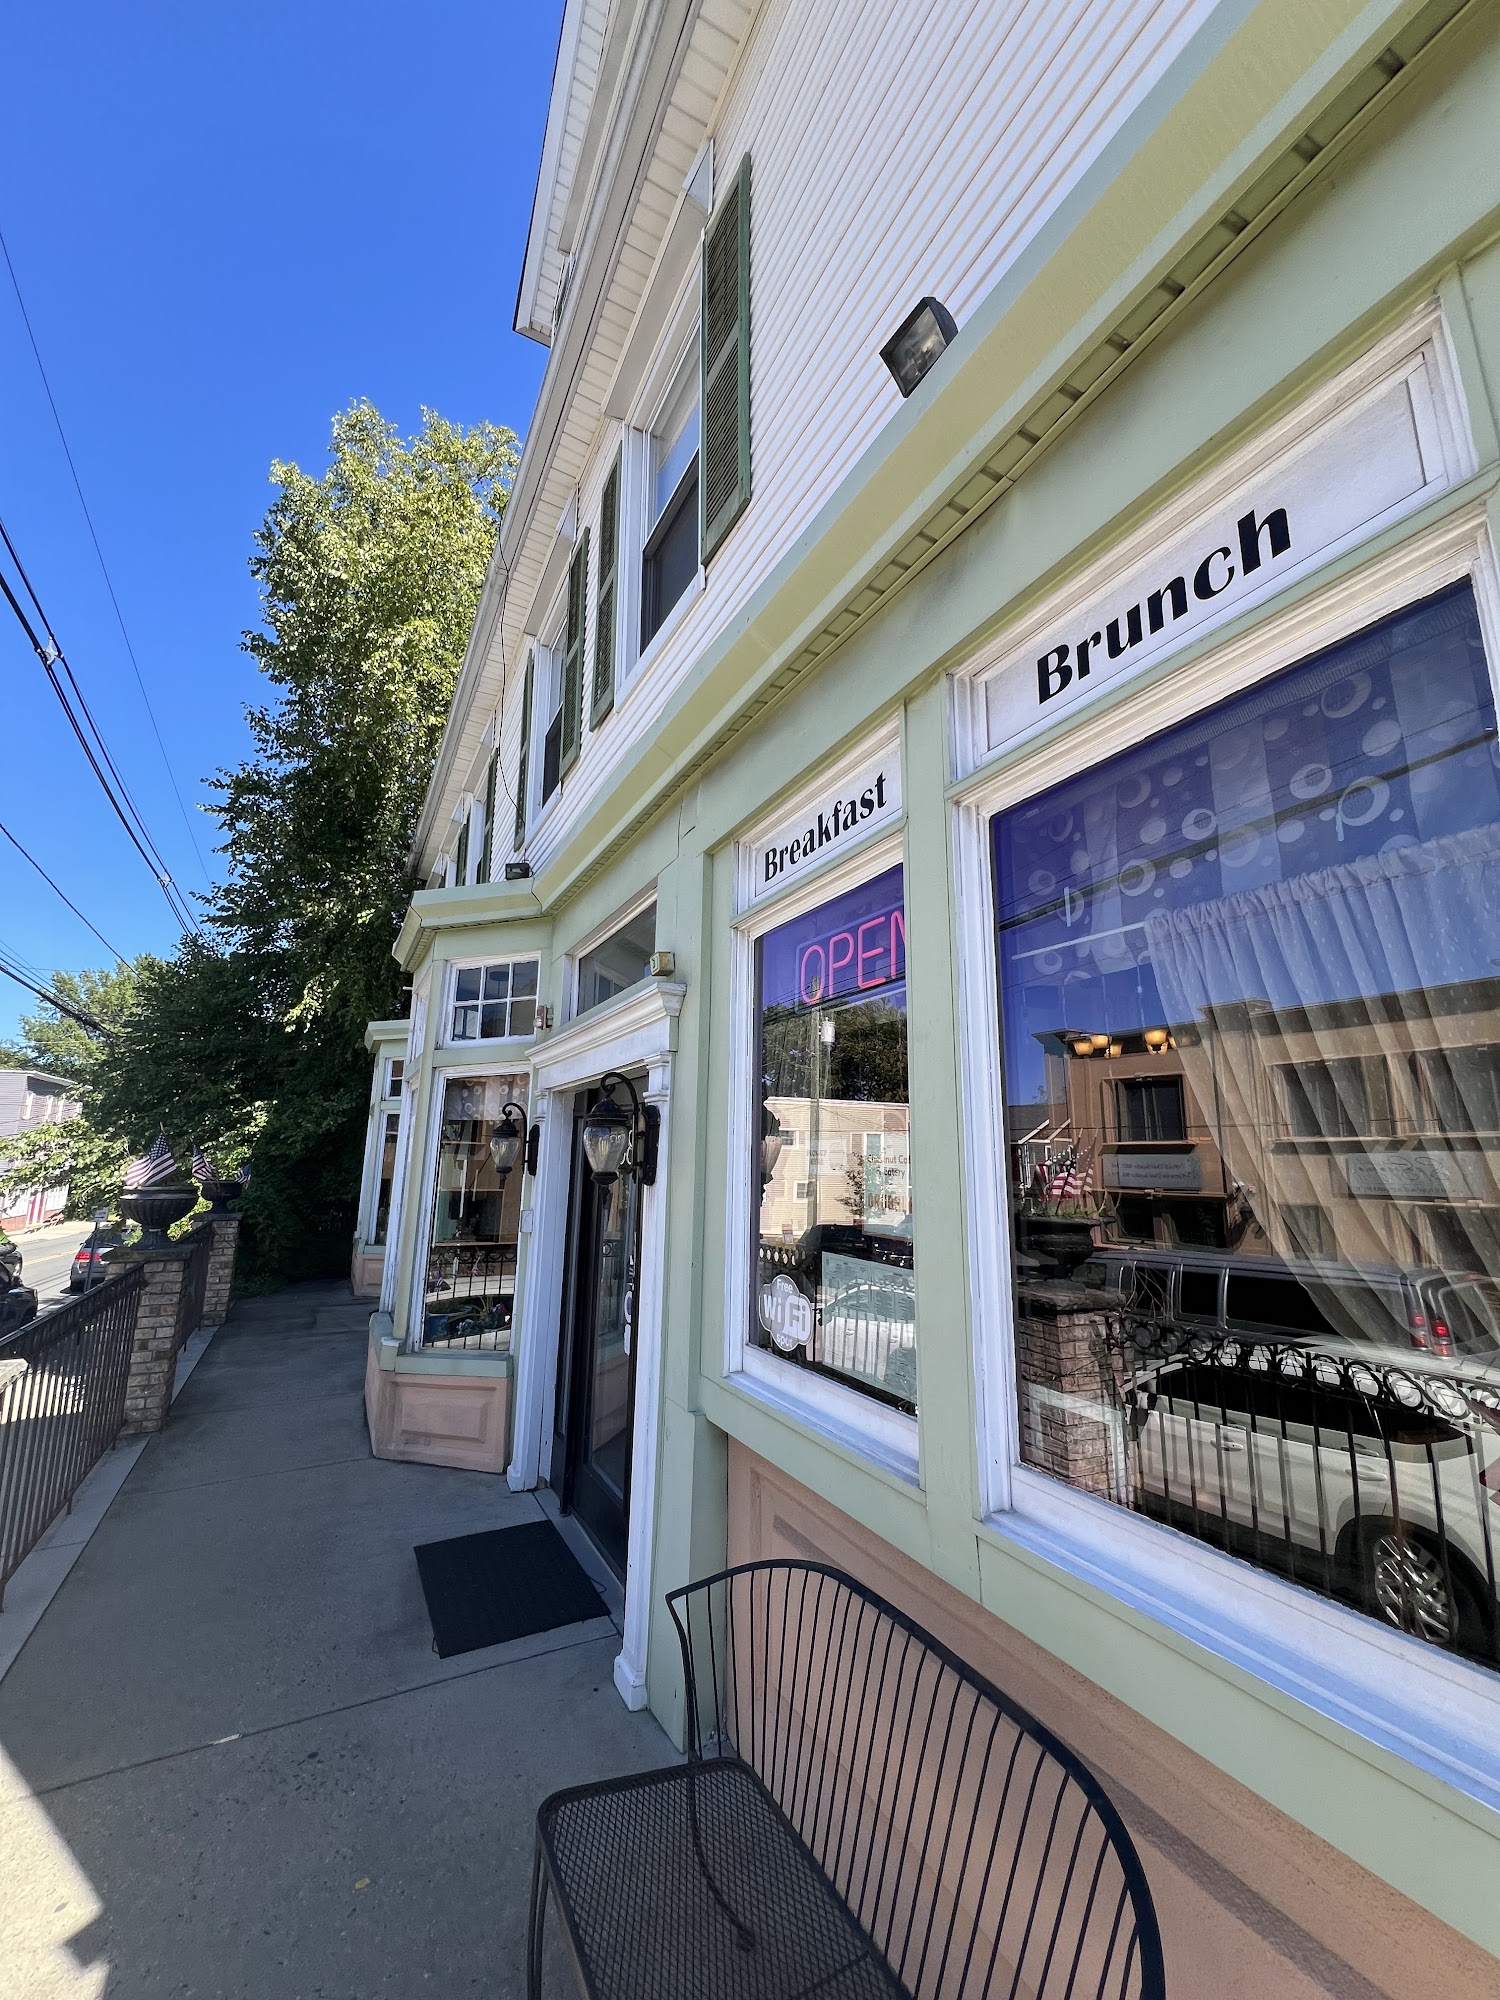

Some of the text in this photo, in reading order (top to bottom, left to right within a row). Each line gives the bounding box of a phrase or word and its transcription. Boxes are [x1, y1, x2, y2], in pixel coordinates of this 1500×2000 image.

[1037, 507, 1291, 705] Brunch
[764, 771, 887, 883] Breakfast
[776, 1279, 793, 1294] Free
[776, 1333, 793, 1349] spot
